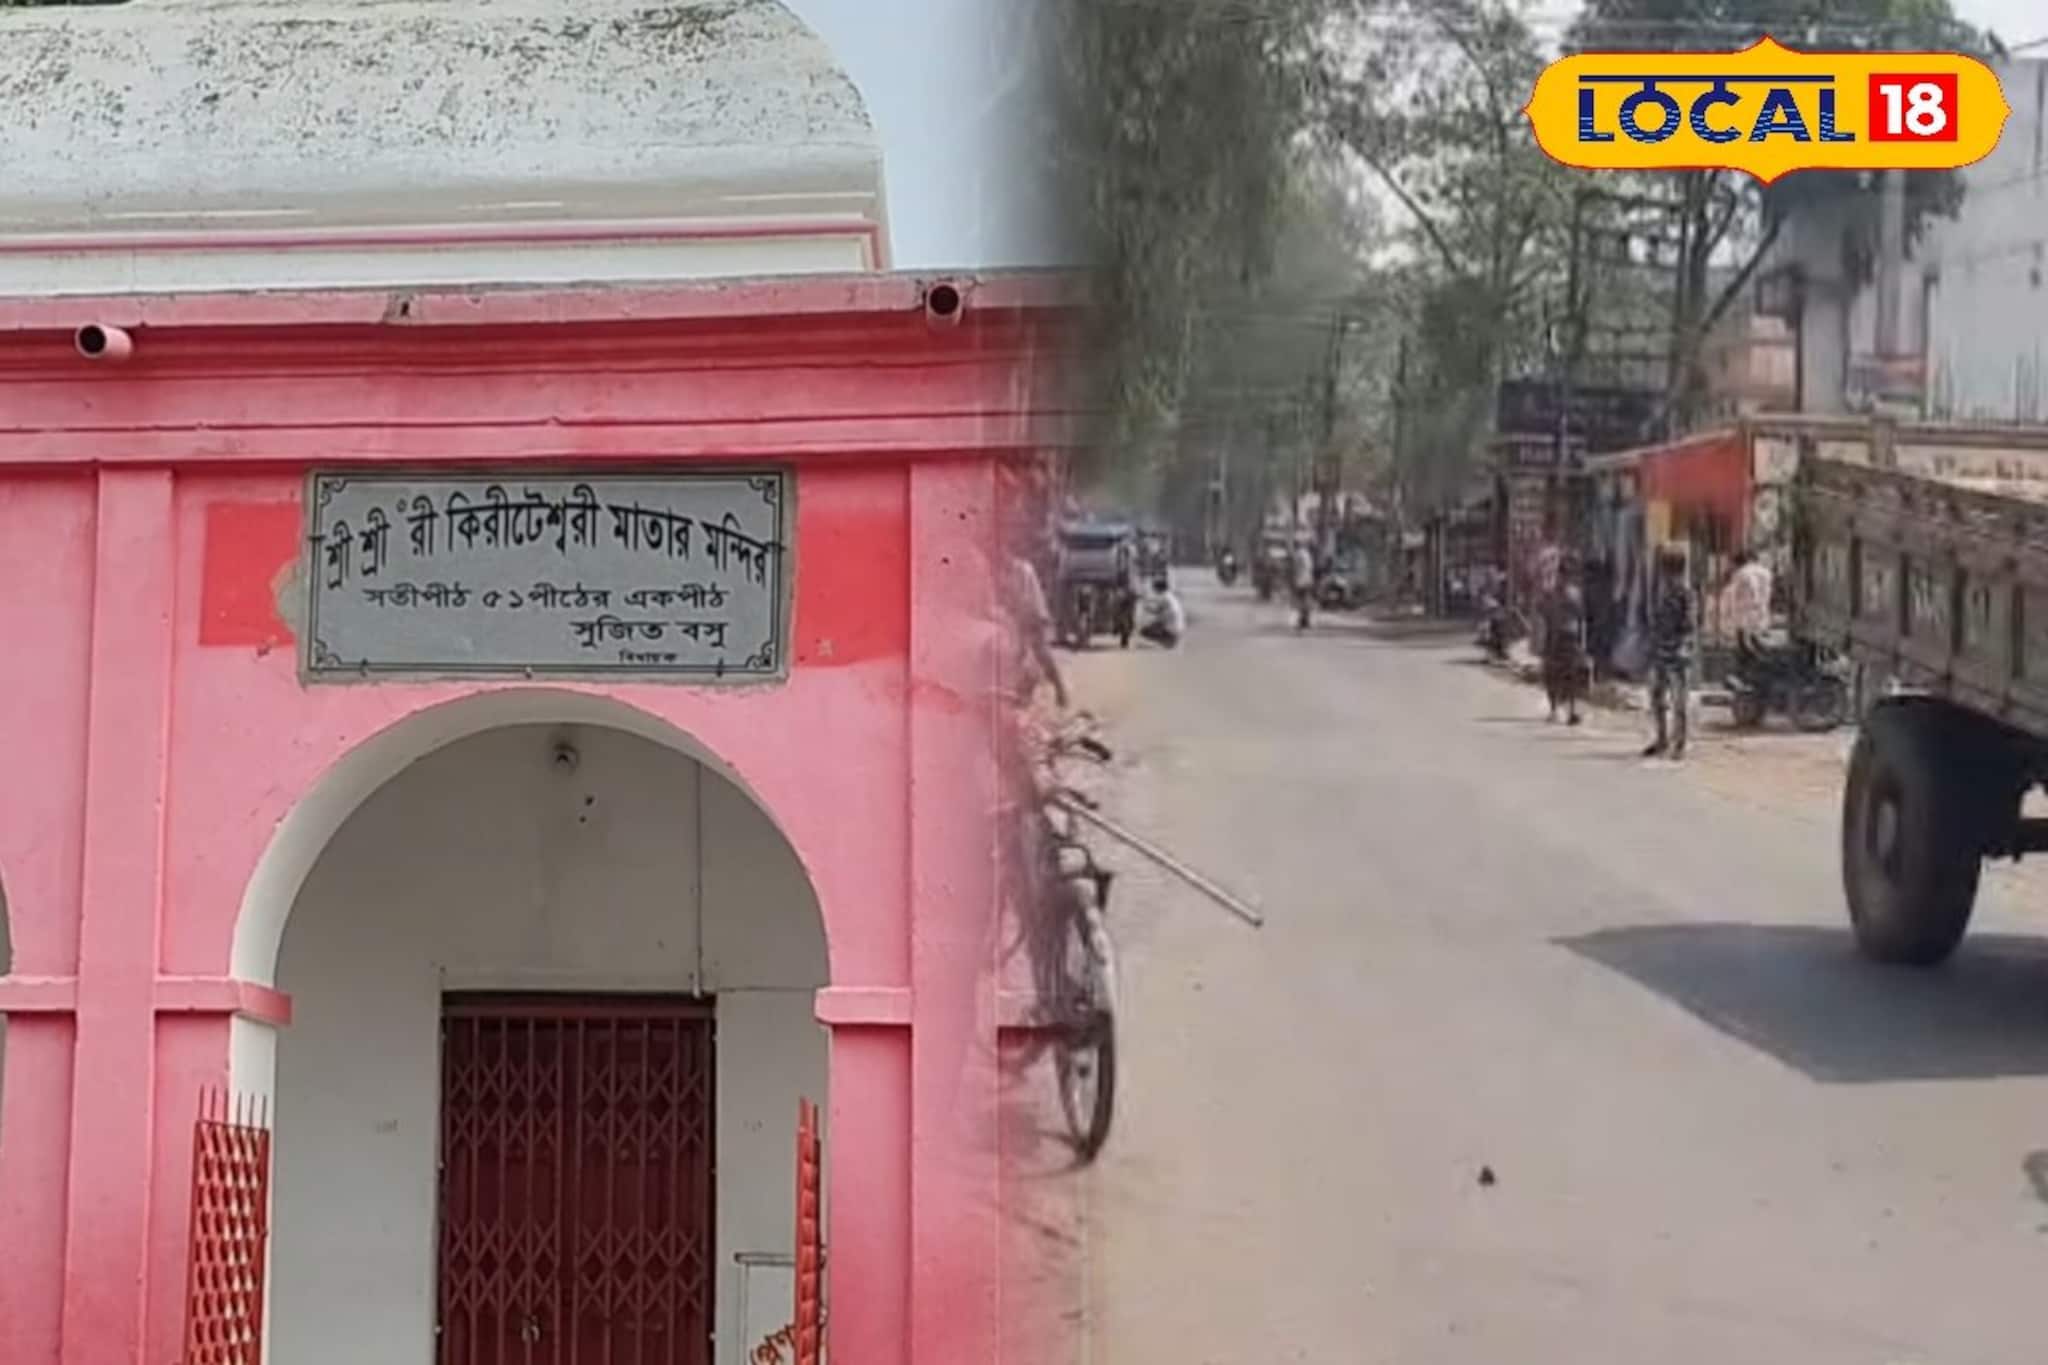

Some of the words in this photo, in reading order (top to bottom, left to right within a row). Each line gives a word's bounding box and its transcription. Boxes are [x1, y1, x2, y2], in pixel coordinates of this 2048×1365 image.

[325, 520, 353, 590] শ্রী
[358, 507, 391, 576] শ্রী
[606, 501, 694, 560] মাতার
[700, 511, 770, 588] মন্দির
[568, 613, 670, 649] সুজিত
[674, 621, 730, 648] বসু
